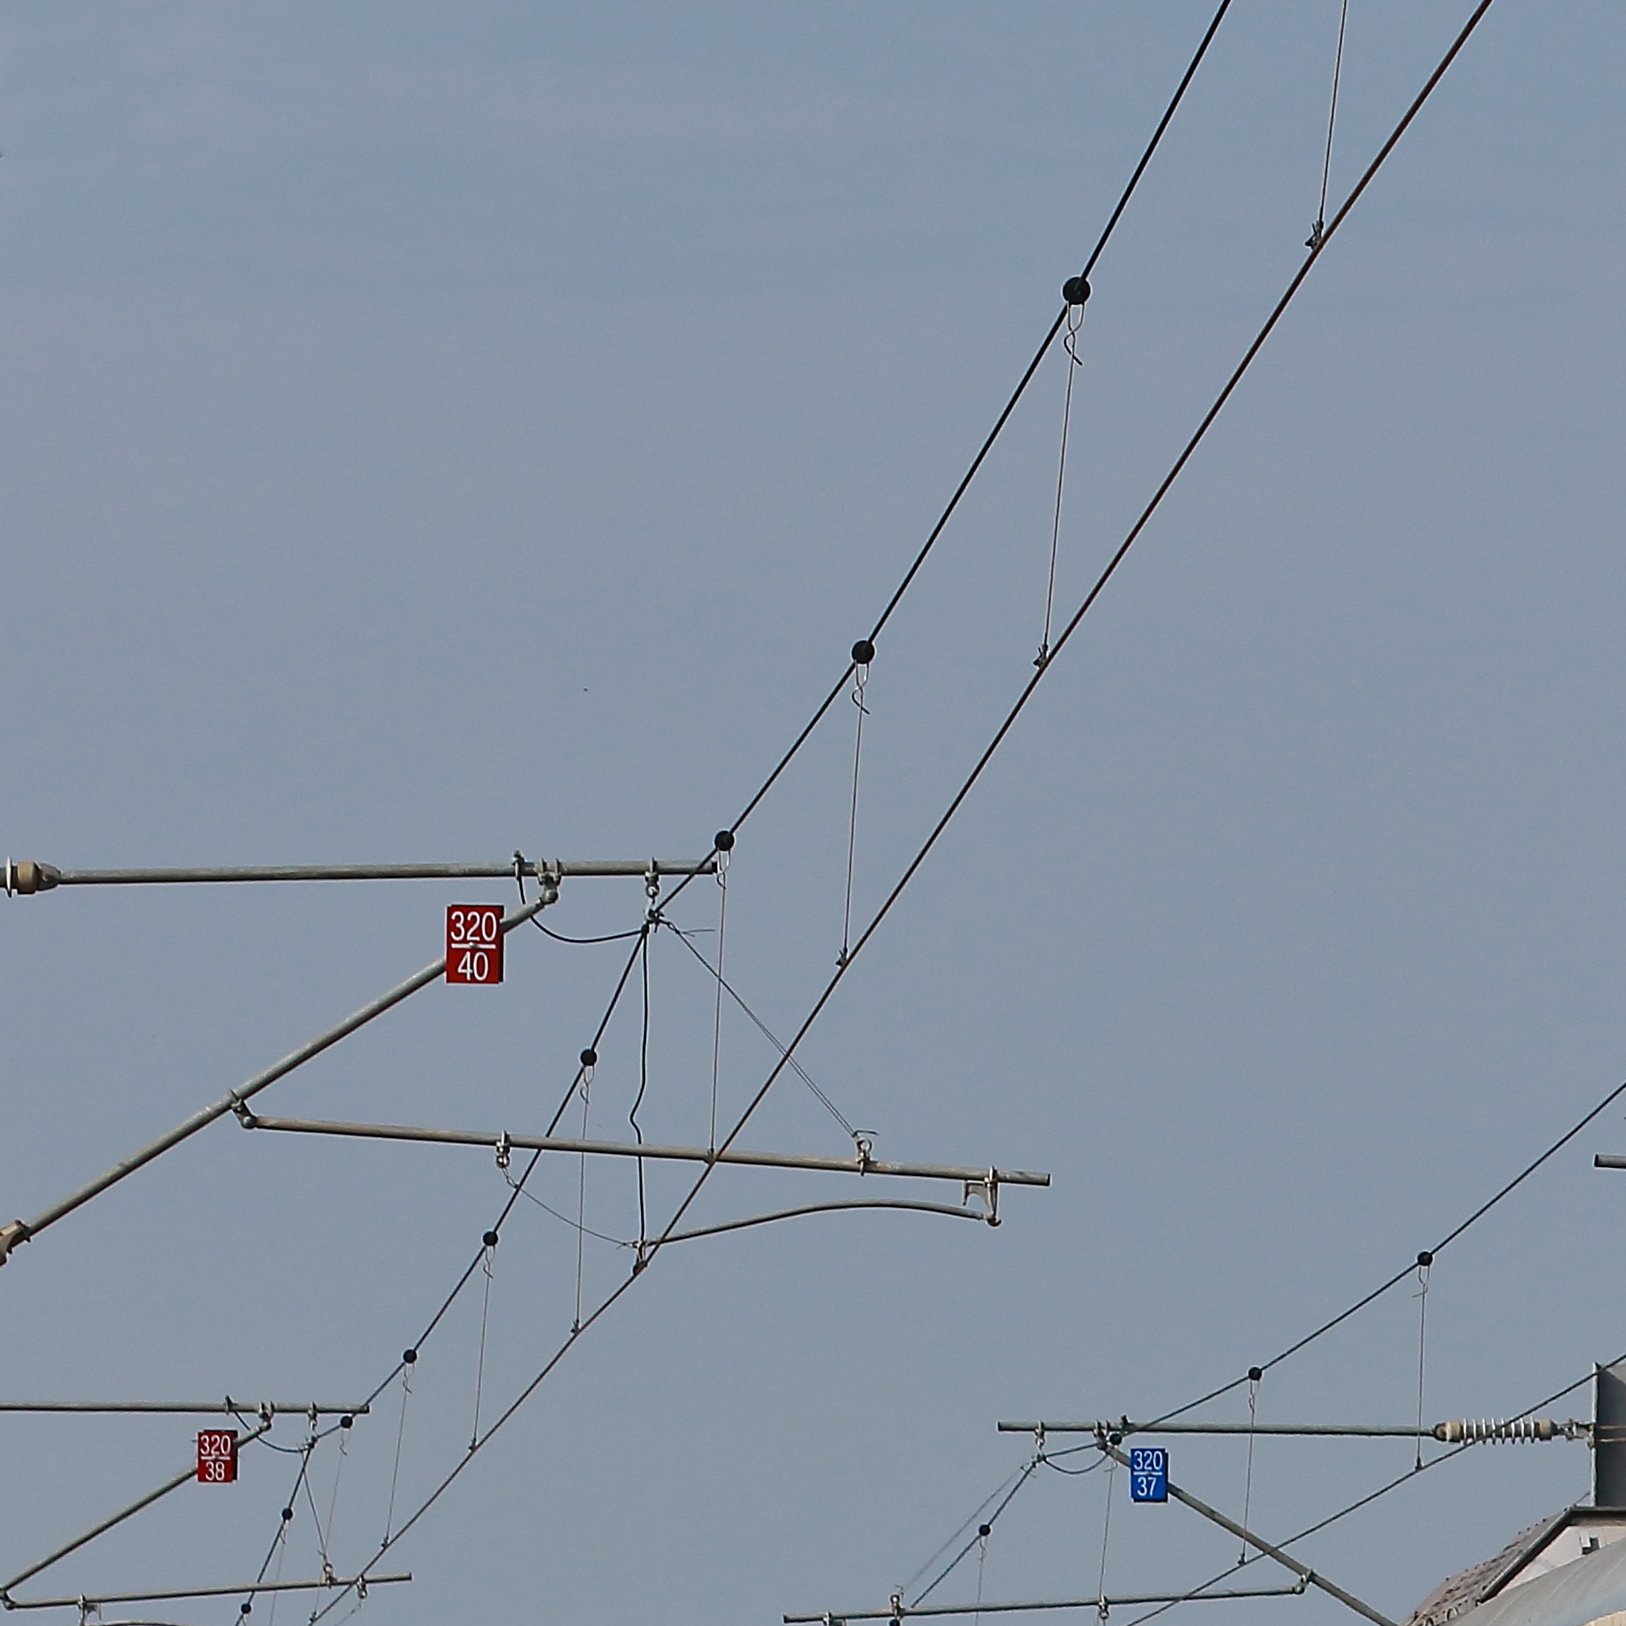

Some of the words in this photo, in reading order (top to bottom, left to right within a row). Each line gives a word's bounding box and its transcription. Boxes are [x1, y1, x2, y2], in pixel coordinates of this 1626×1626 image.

[450, 911, 497, 942] 320
[457, 951, 489, 981] 40
[200, 1434, 231, 1455] 320
[1133, 1450, 1163, 1470] 320
[205, 1461, 225, 1481] 38
[1137, 1477, 1157, 1496] 37
